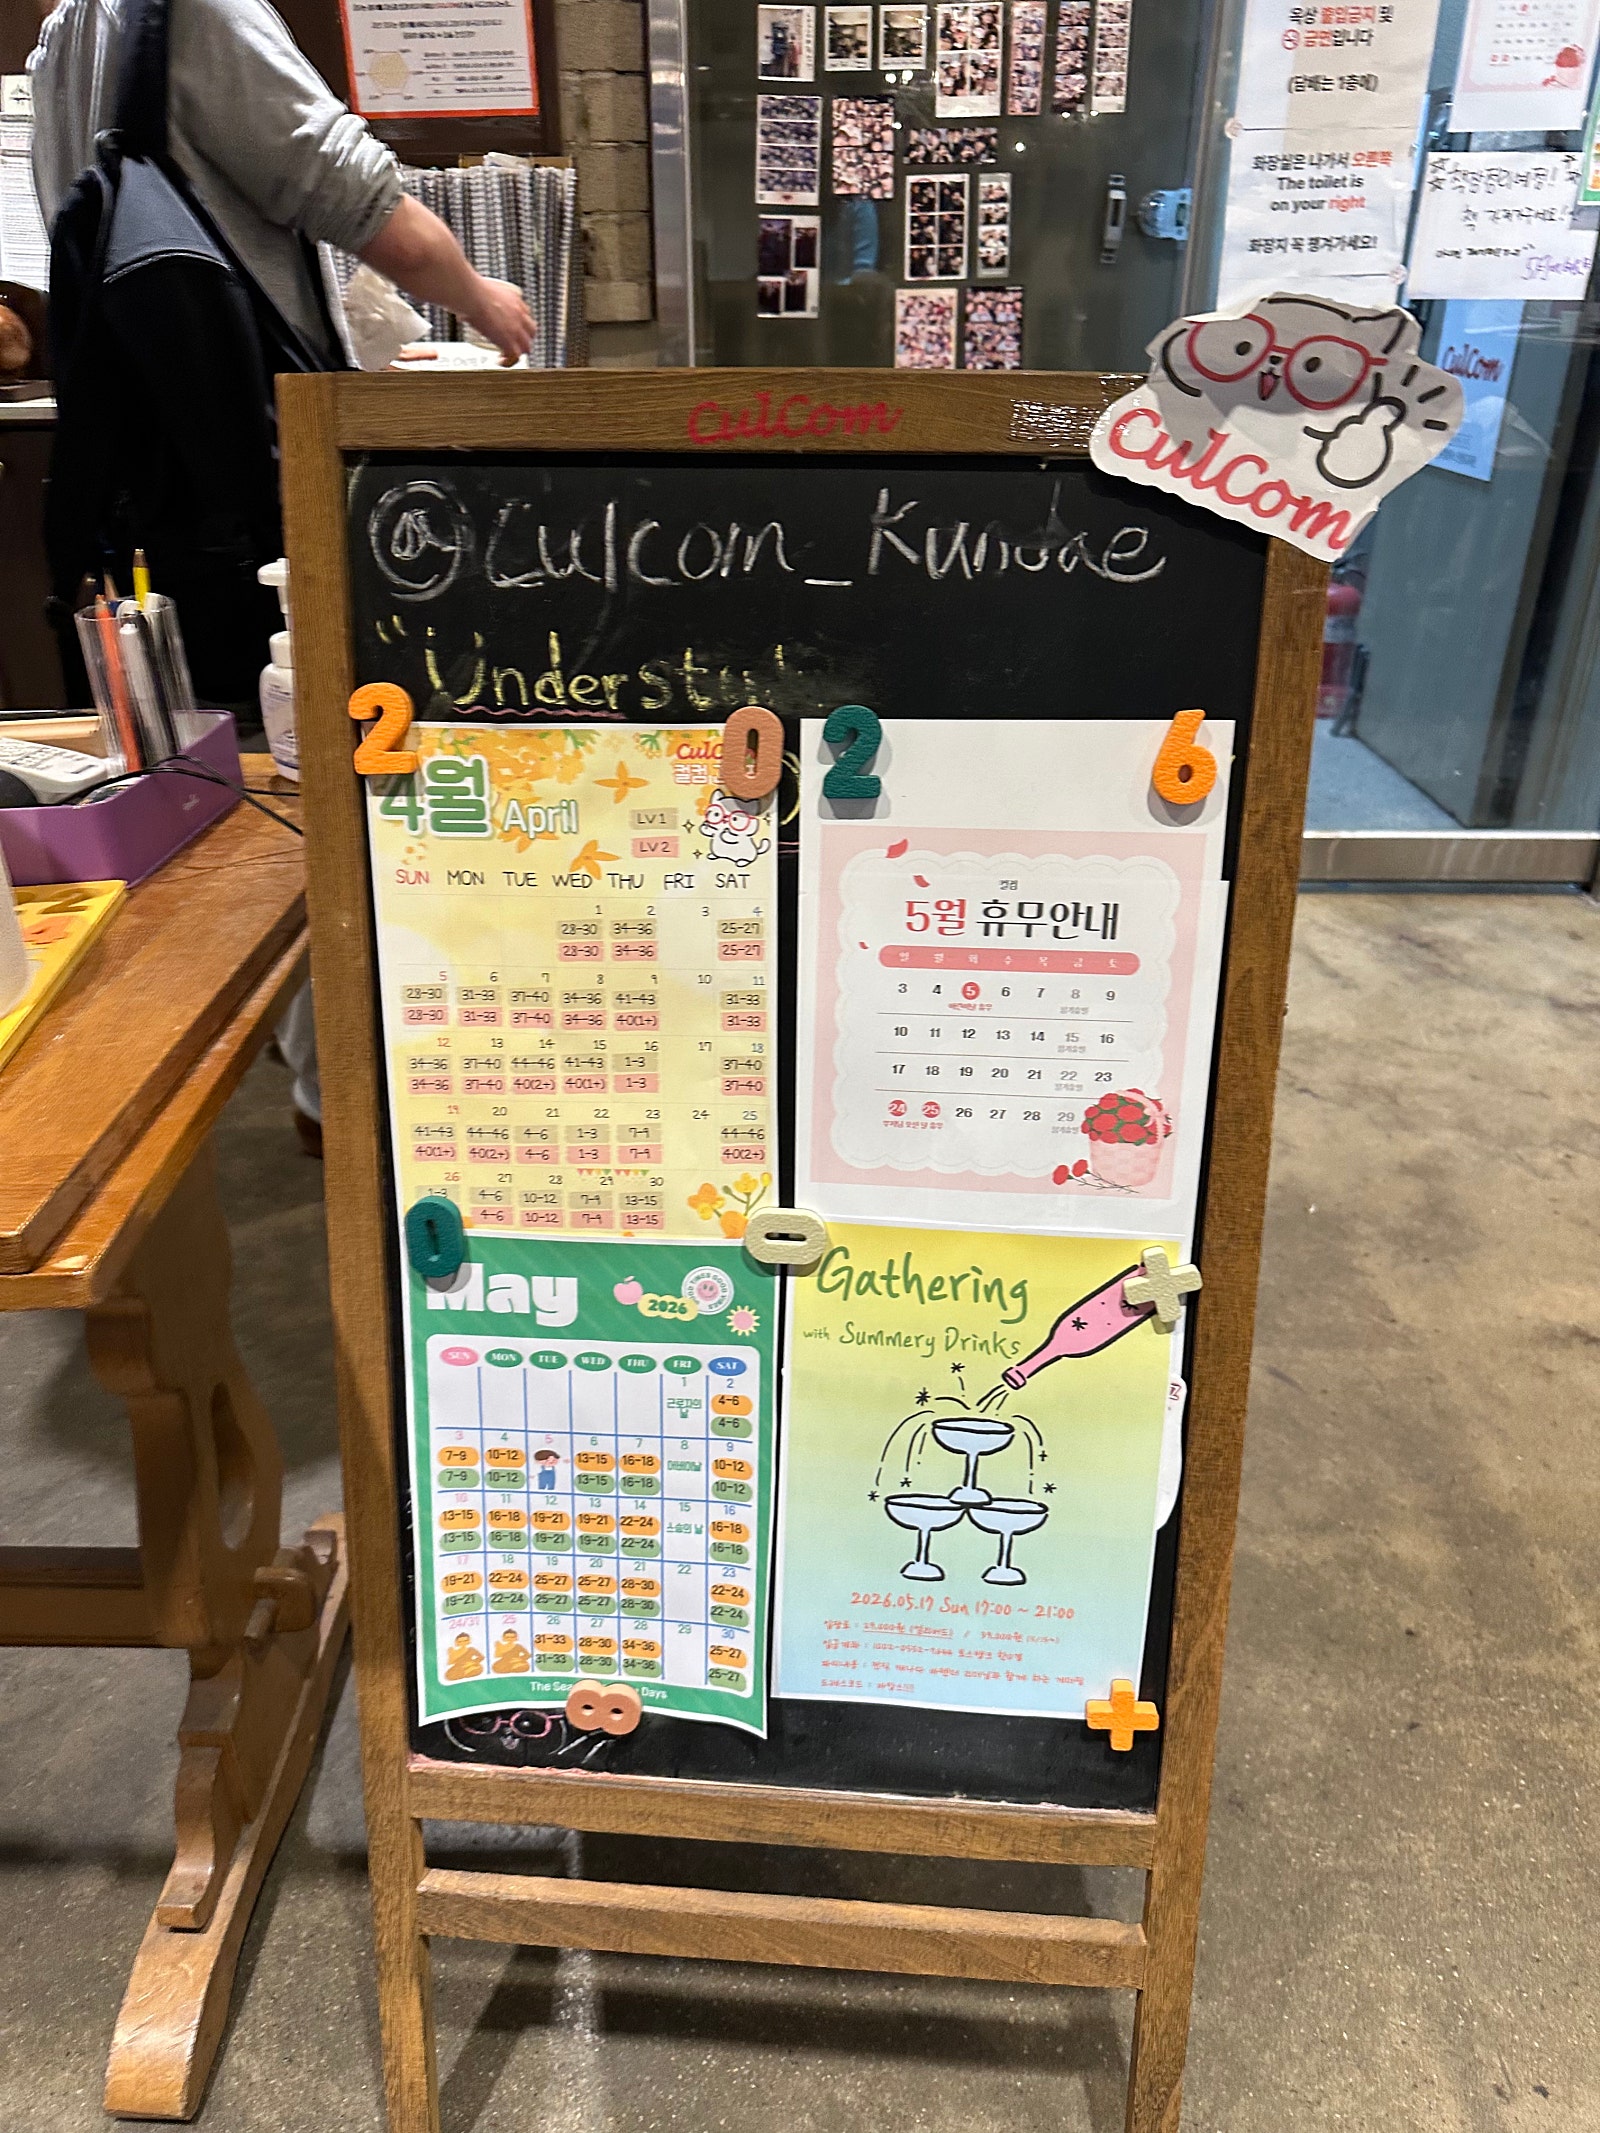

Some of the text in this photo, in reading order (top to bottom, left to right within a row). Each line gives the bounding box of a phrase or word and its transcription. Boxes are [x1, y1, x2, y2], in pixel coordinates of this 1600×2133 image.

[1289, 5, 1394, 25] 옥상 출입금지 및
[1304, 28, 1374, 47] 금연입니다
[1252, 150, 1393, 171] 화장실은 나가서 오른쪽
[1277, 174, 1364, 190] The toilet is
[1270, 195, 1366, 214] on your right
[1248, 235, 1378, 254] 화장지 꼭 챙겨가세요!
[687, 391, 904, 445] CulCom
[1108, 407, 1351, 550] CulCom
[348, 682, 418, 775] 2
[722, 706, 785, 799] 0
[822, 704, 881, 799] 2
[1152, 708, 1218, 806] 6
[677, 741, 723, 760] CulC
[379, 757, 578, 839] 4월 April
[396, 869, 752, 890] SUN MON TUE WED THU FRI SAT
[561, 922, 760, 936] 28-30 34-36 25-27
[905, 899, 1120, 940] 5월 휴무안내
[563, 944, 761, 957] 28-30 34-36 25-27
[406, 988, 761, 1006] 28-30 31-33 37-40 34-36 41-43 31-33
[407, 1009, 761, 1027] 28-30 31-33 37-40 34-36 40(1+) 31-33
[894, 1026, 1115, 1044] 10 11 12 13 14 15 16
[892, 1064, 1112, 1082] 17 18 19 20 21 22 23
[888, 1103, 1075, 1122] 24 25 26 27 28 29
[523, 1192, 657, 1206] 10-12 13-15
[525, 1212, 658, 1225] 10-12 13-15
[817, 1246, 1029, 1324] Gathering
[427, 1263, 687, 1328] May 2026
[803, 1322, 1021, 1359] with Summery Drinks
[491, 1353, 517, 1362] MON
[538, 1354, 559, 1364] TUE
[581, 1356, 605, 1366] WED
[627, 1358, 648, 1367] THU
[673, 1360, 692, 1369] FRI
[716, 1361, 738, 1370] SAT
[718, 1396, 740, 1406] 4-6
[718, 1418, 740, 1428] 4-6
[446, 1449, 745, 1472] 7-9 10-12 13-15 16-18 10-12
[446, 1472, 745, 1494] 7-9 10-12 13-15 16-18 10-12
[442, 1510, 742, 1534] 13-15 16-18 19-21 19-21 22-24 16-18
[851, 1592, 935, 1612] 2026.05.17
[939, 1597, 970, 1616] Sun
[975, 1599, 1012, 1616] 17:00
[1034, 1605, 1075, 1619] 21:00
[530, 1681, 551, 1692] The
[641, 1688, 668, 1700] Days
